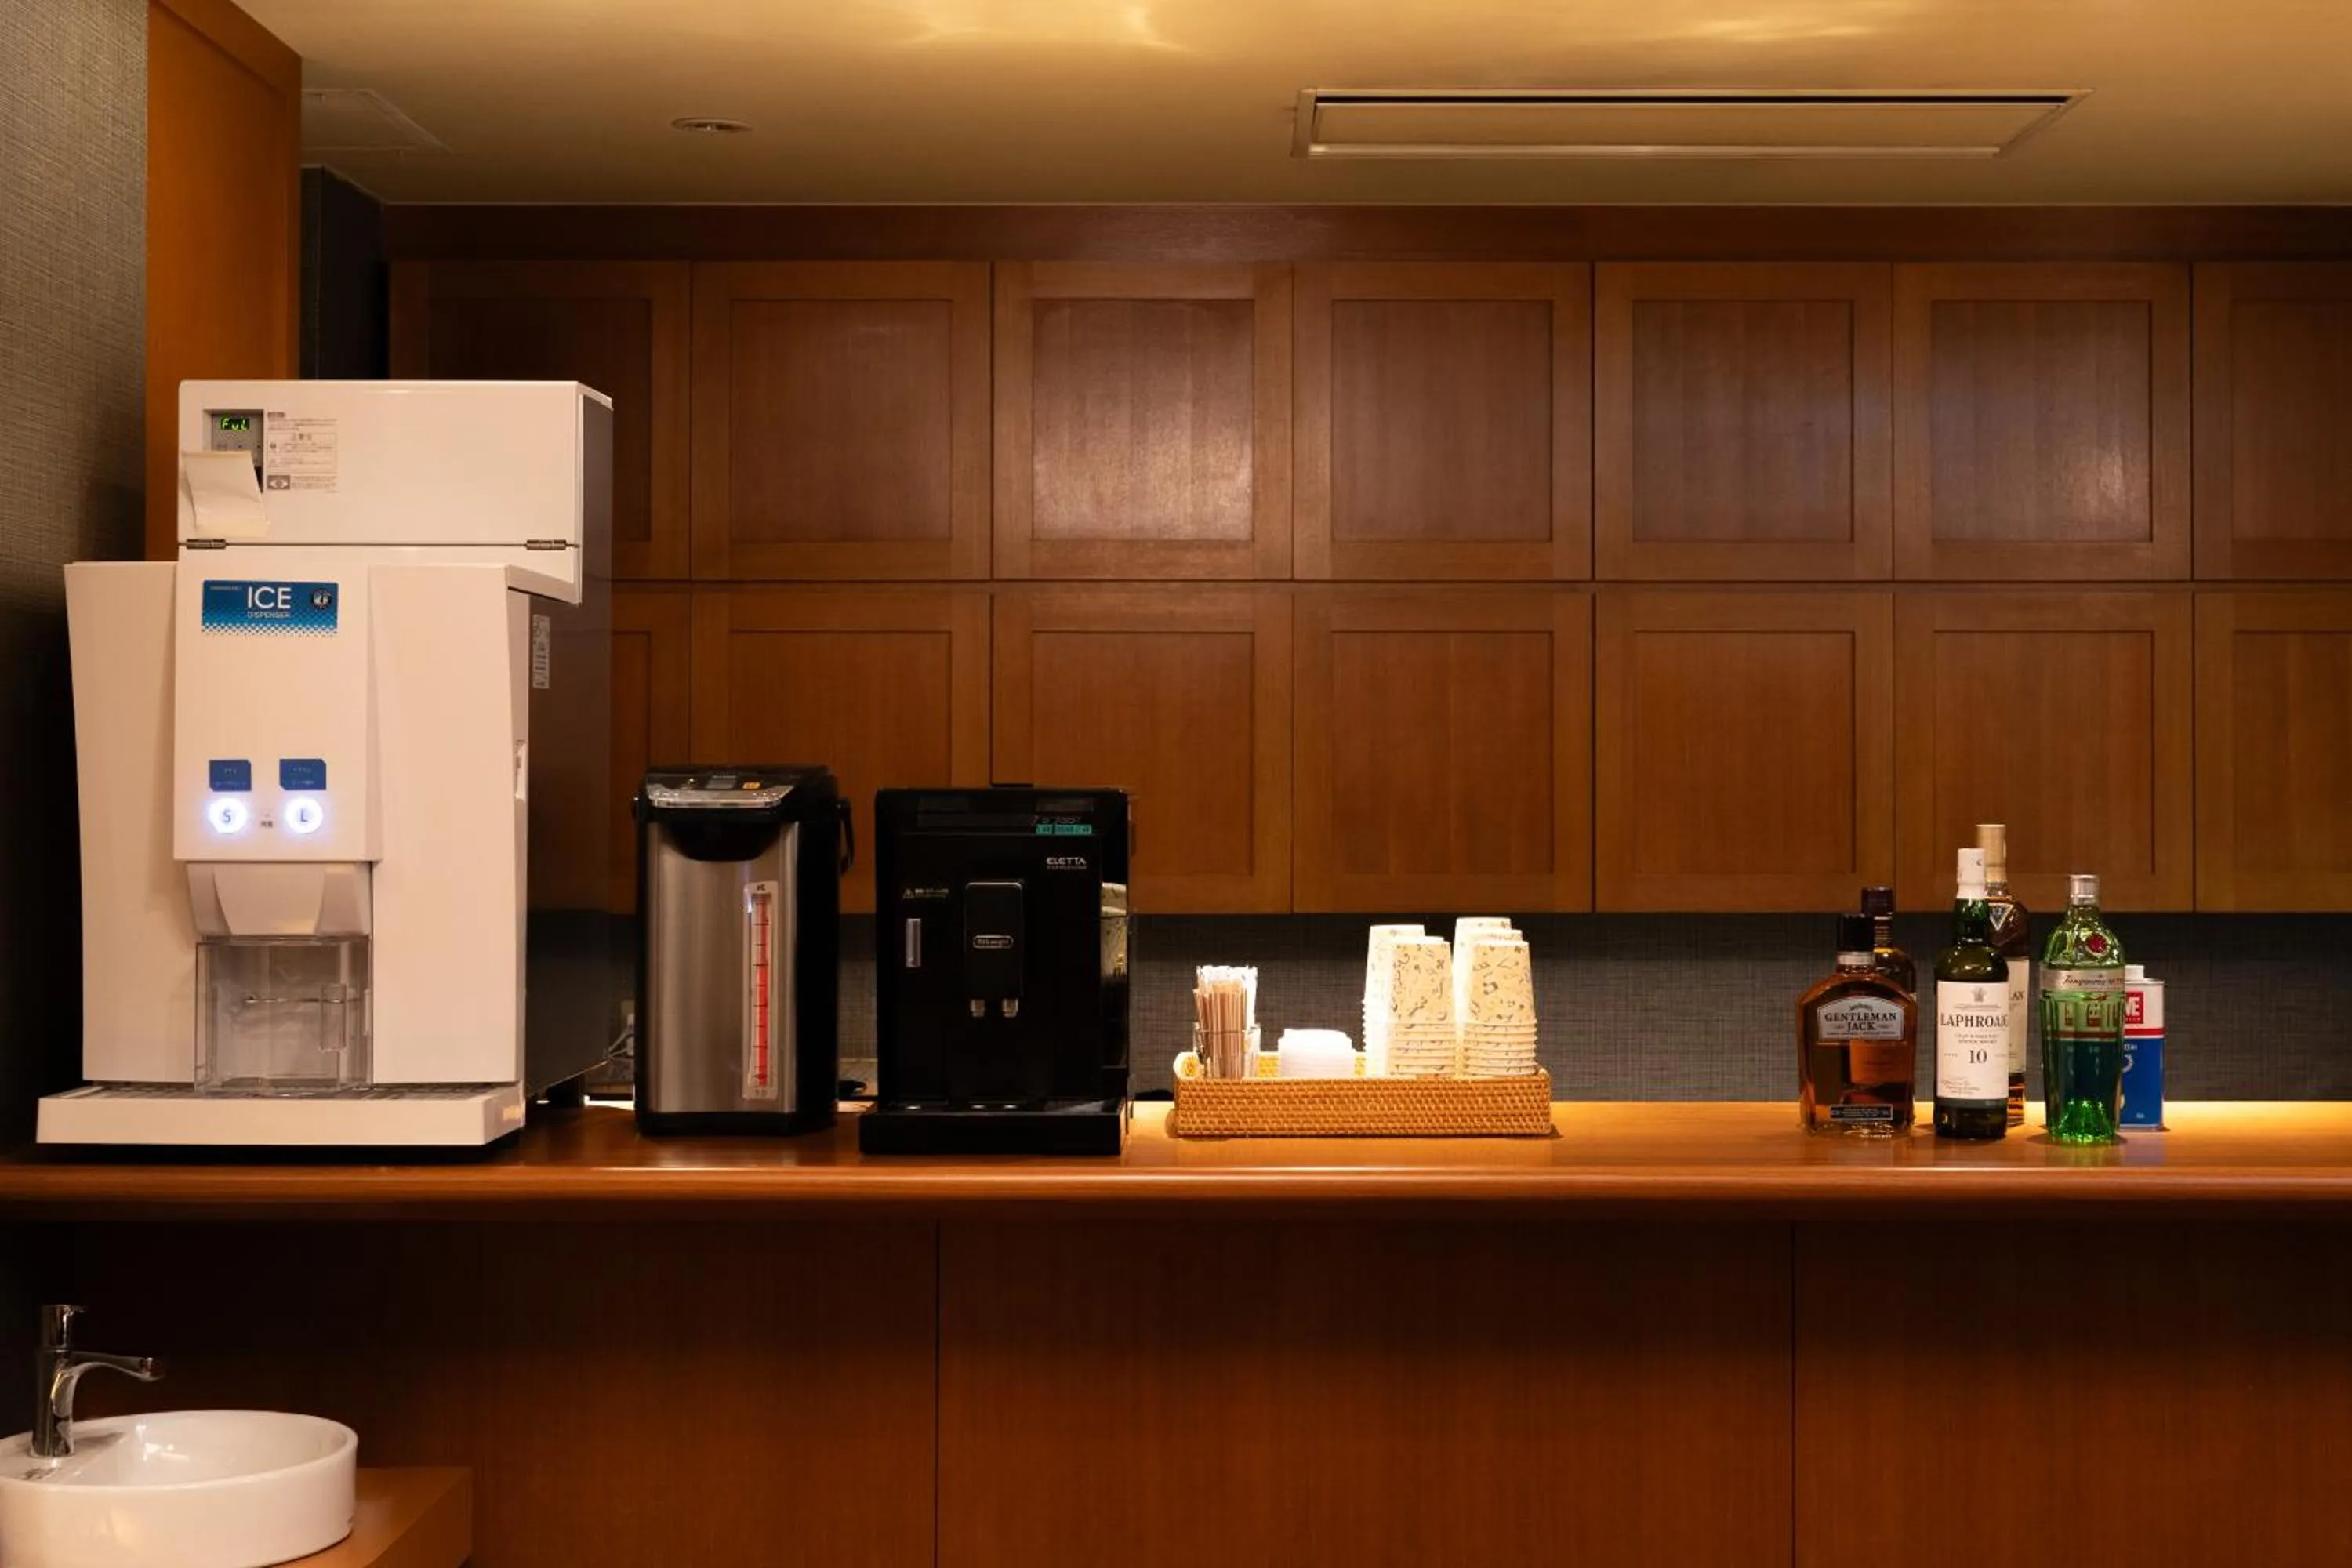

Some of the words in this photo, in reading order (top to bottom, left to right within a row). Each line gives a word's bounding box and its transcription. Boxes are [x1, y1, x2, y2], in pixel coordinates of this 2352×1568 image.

[247, 586, 292, 609] ICE
[223, 809, 232, 824] S
[299, 808, 308, 822] L
[1824, 1012, 1897, 1022] GENTLEMAN
[1847, 1022, 1877, 1032] JACK
[1969, 1049, 1987, 1064] 10
